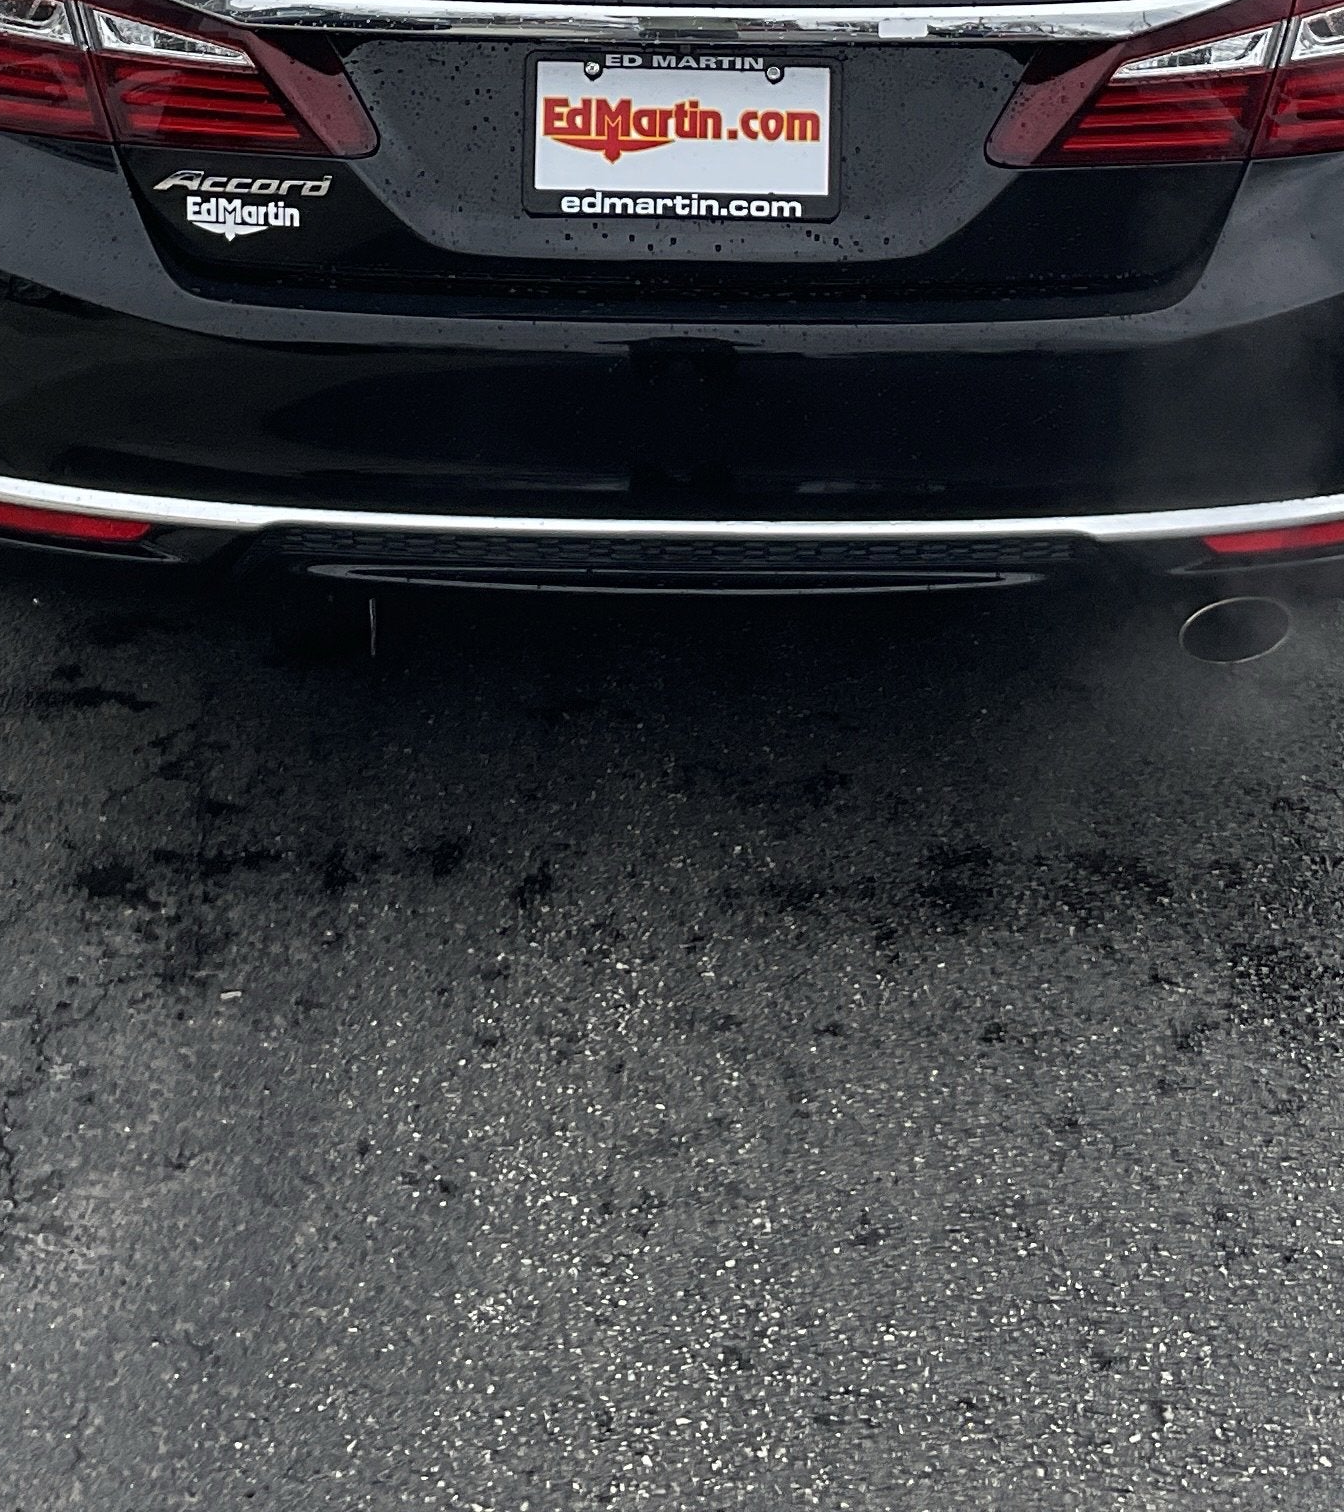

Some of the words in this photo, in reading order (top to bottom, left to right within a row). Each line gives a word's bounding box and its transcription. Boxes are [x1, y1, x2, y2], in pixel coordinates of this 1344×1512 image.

[605, 54, 642, 67] ED
[651, 55, 765, 70] MARTIN
[542, 96, 821, 143] EdMartin.com
[154, 169, 333, 197] Accord
[186, 195, 301, 228] EdMartin
[560, 191, 803, 218] edmartin.com
